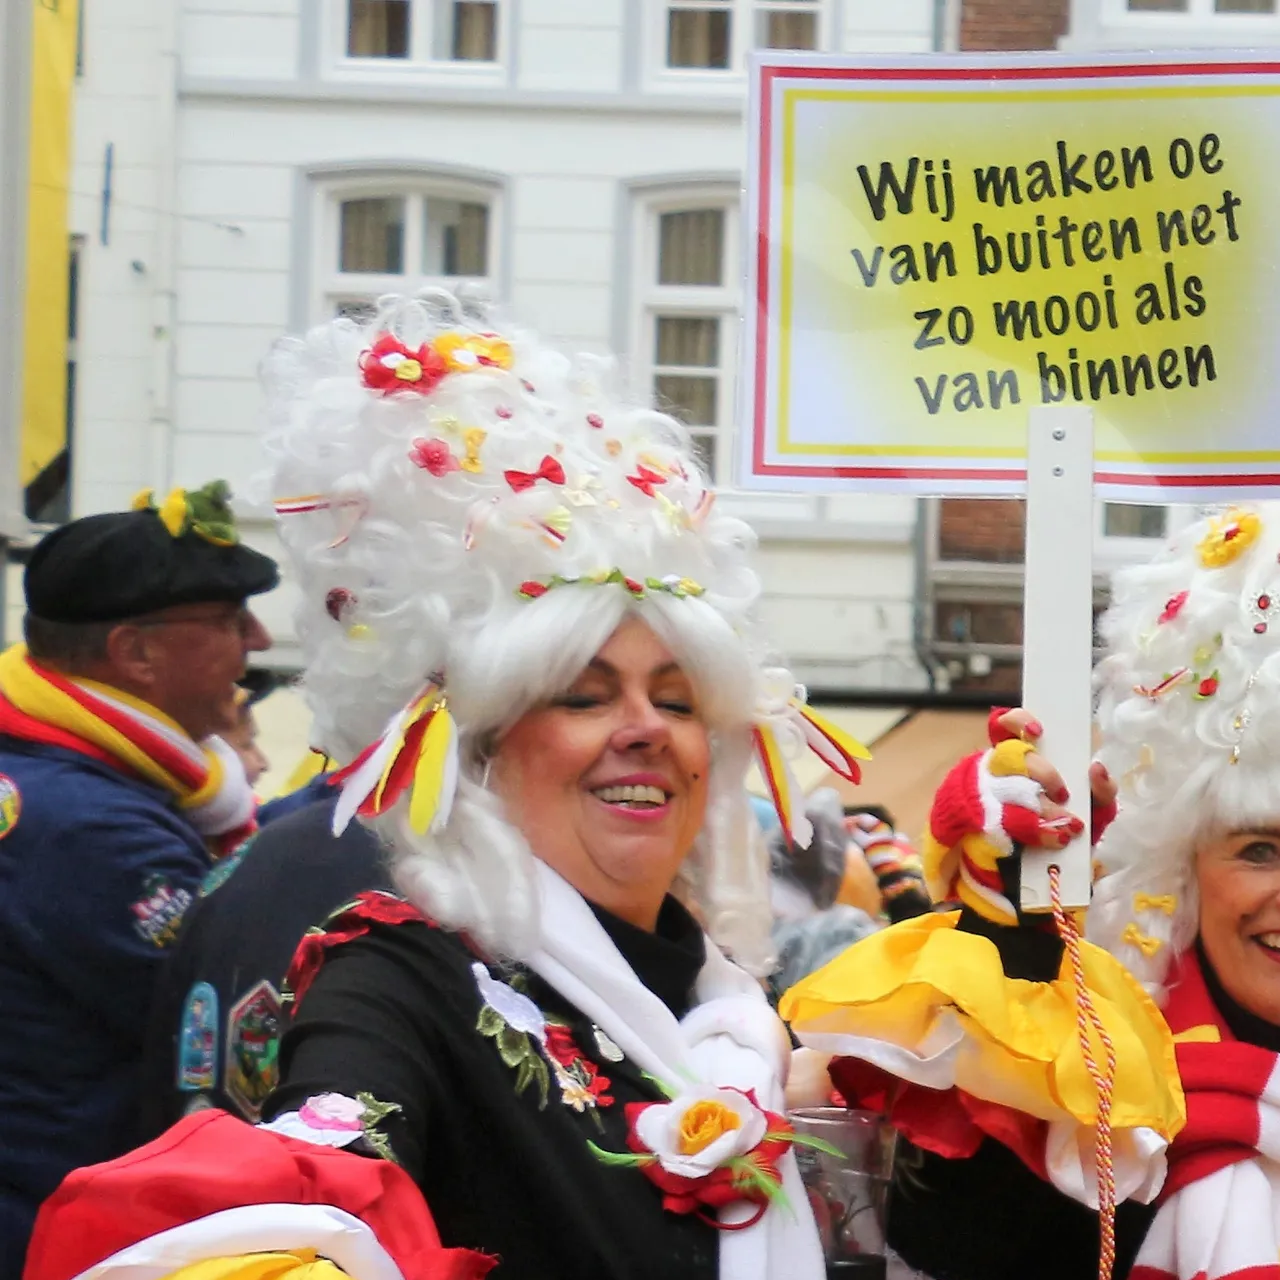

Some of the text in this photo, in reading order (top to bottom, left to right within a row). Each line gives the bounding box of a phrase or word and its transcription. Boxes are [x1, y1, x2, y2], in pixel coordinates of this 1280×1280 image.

[856, 132, 1224, 222] Wij maken oe
[850, 189, 1242, 288] van buiten net
[913, 263, 1207, 350] zo mooi als
[915, 342, 1218, 415] van binnen
